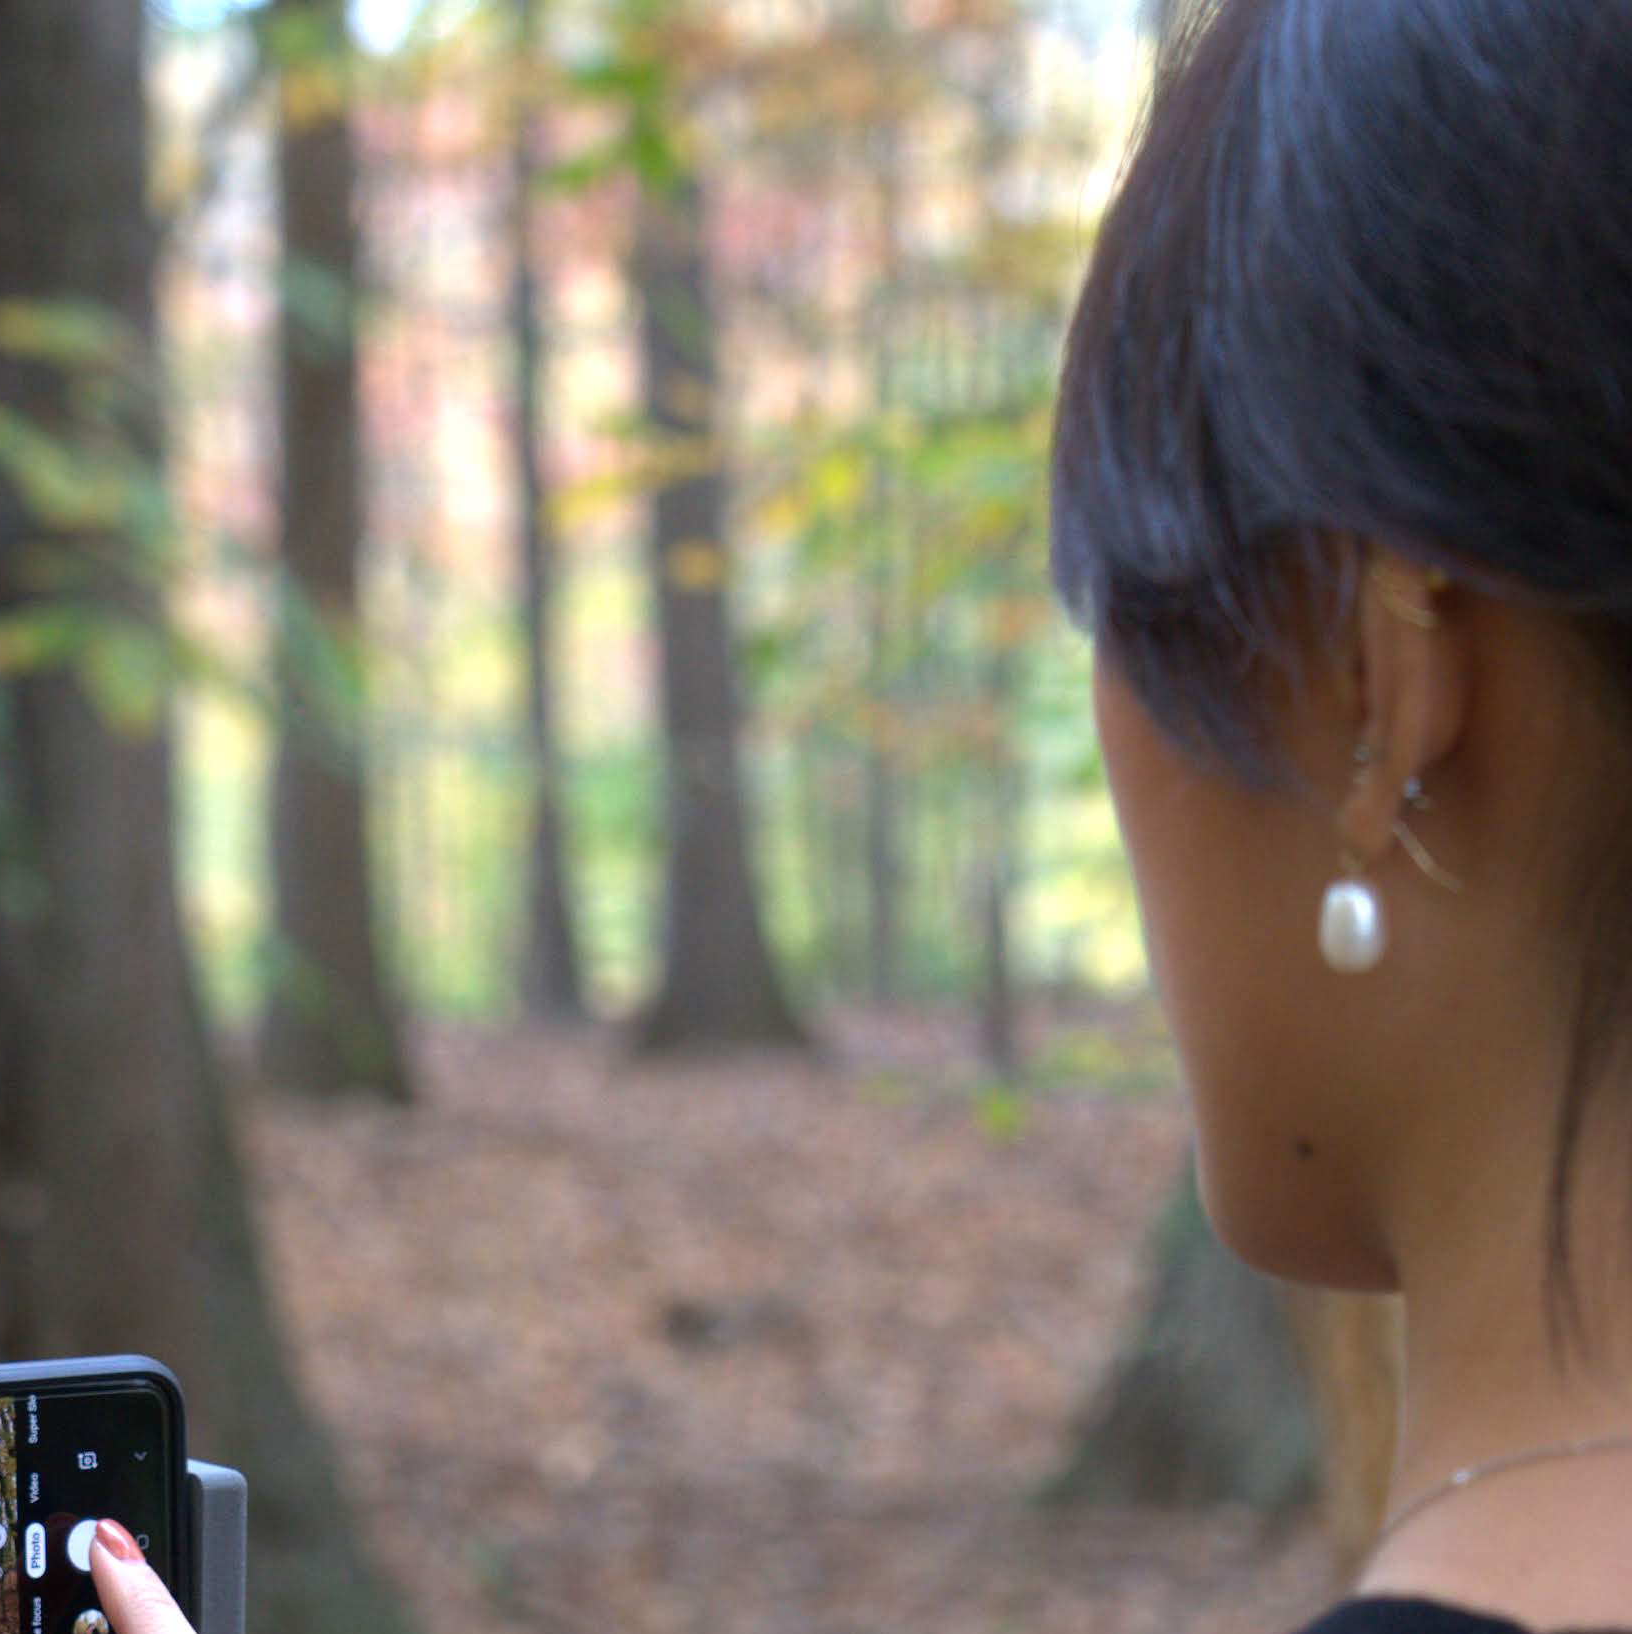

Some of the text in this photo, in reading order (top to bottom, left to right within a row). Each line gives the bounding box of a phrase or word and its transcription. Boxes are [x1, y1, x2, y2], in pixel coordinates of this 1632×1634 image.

[28, 1413, 39, 1444] Super
[30, 1472, 39, 1503] Video
[31, 1532, 41, 1569] Photo
[32, 1596, 42, 1626] focus
